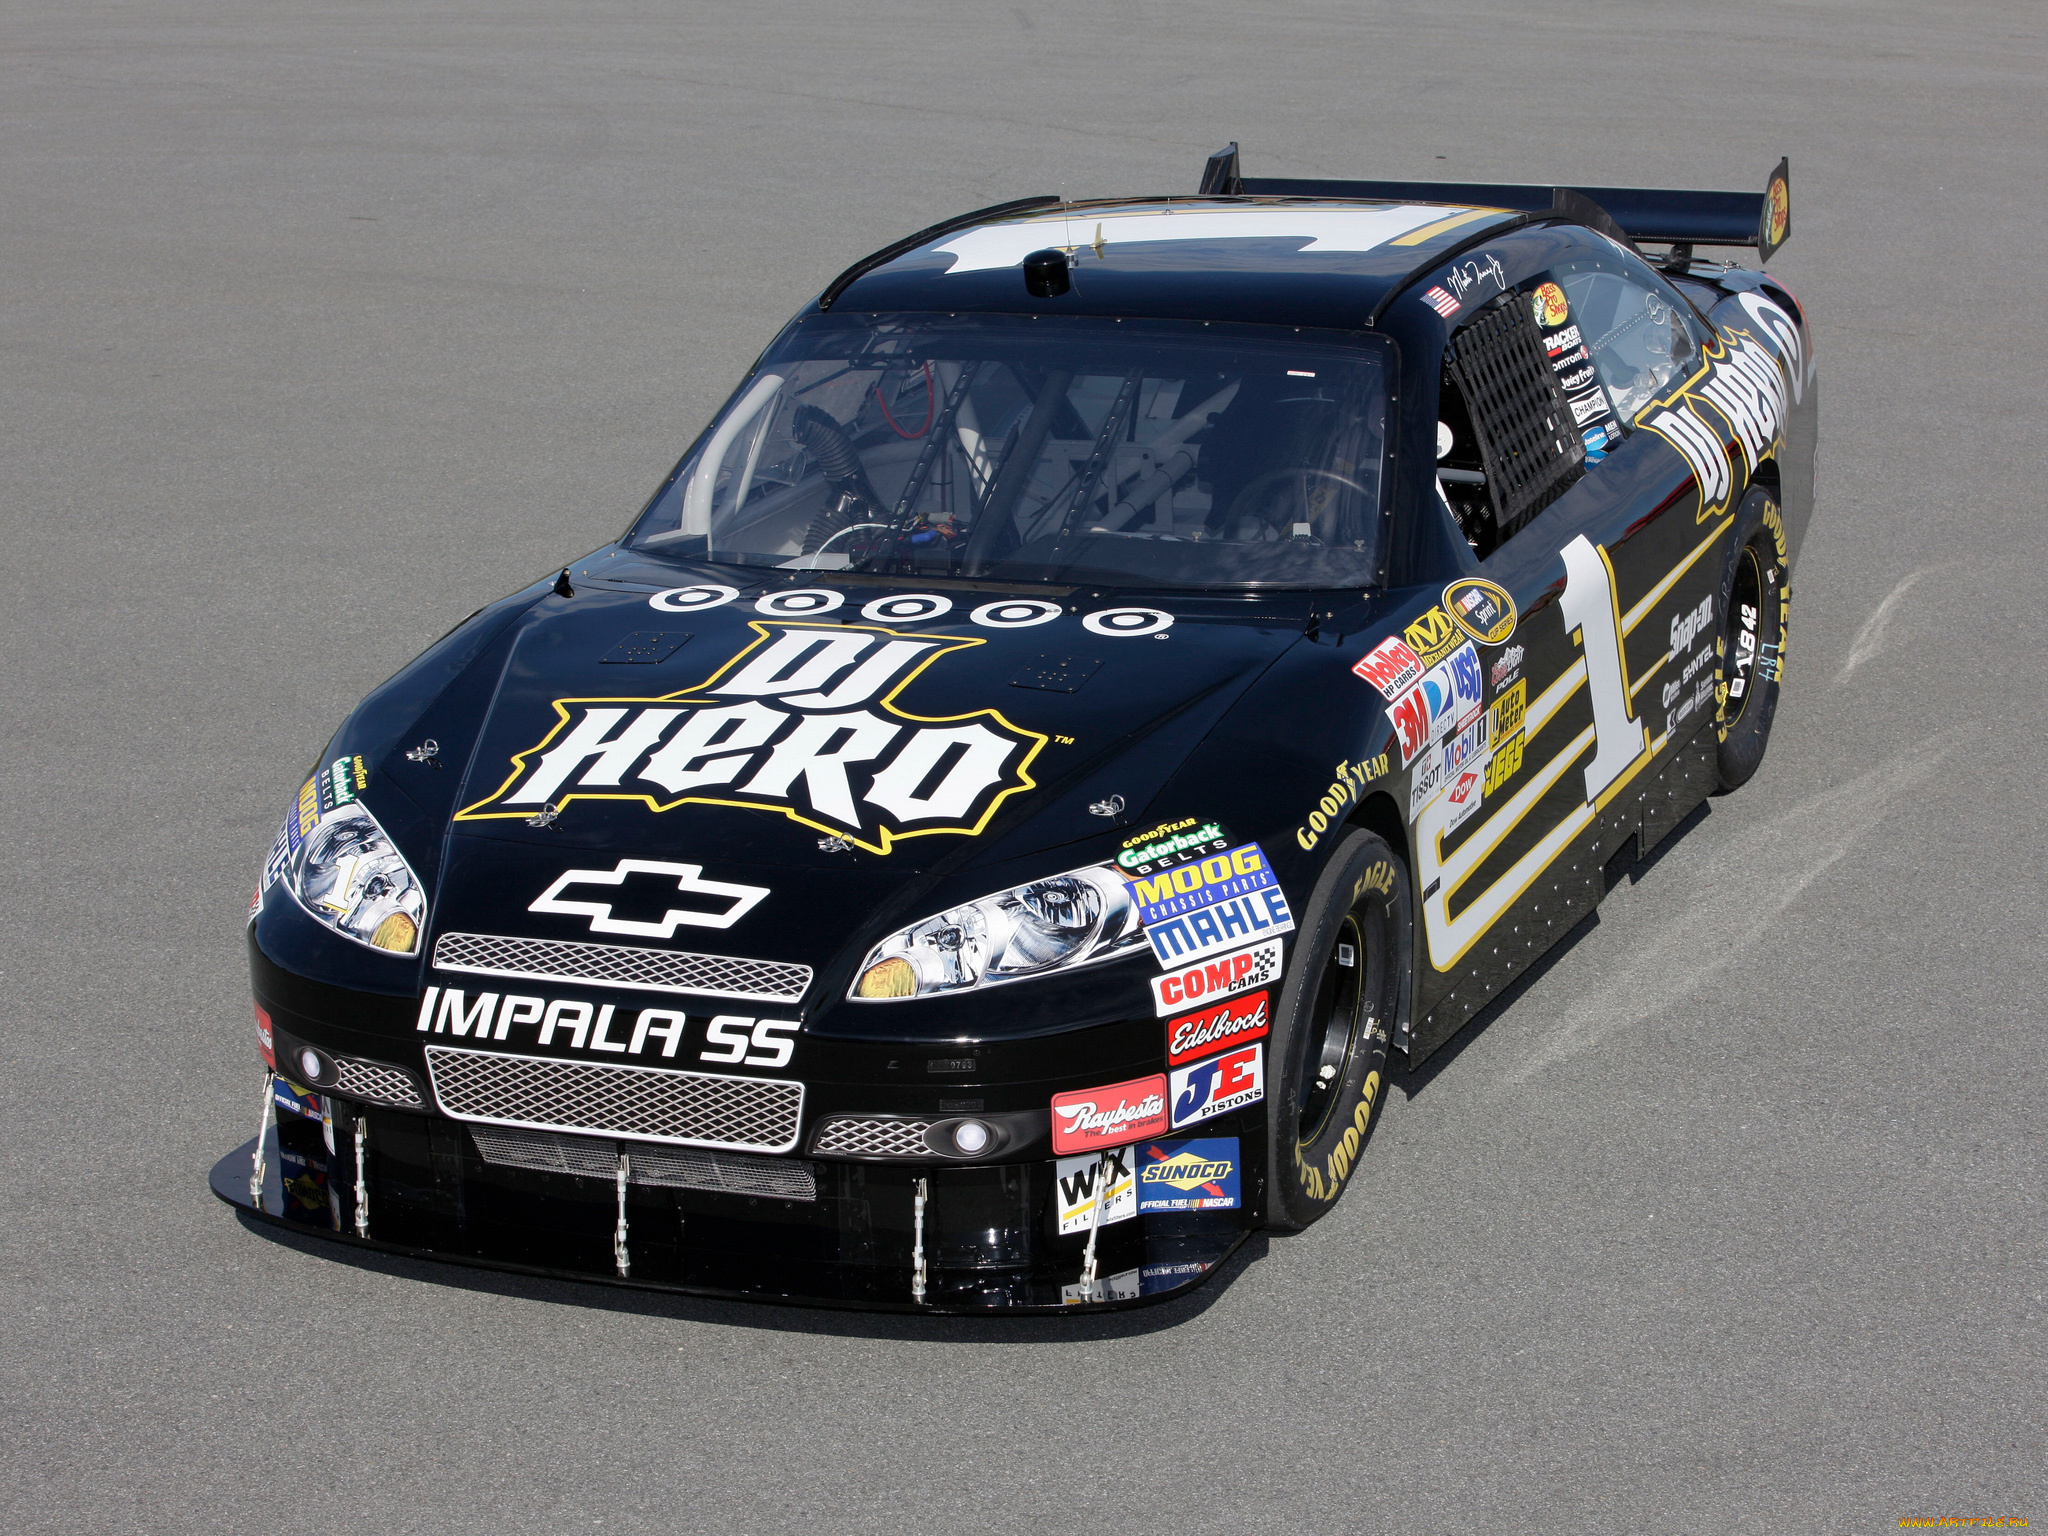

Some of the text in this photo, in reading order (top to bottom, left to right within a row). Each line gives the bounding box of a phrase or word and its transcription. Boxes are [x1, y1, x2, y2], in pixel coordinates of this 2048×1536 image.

[1540, 284, 1556, 297] Bass
[1546, 294, 1558, 306] Pro
[1550, 301, 1567, 317] Shops
[1562, 337, 1582, 351] BOATS
[1561, 374, 1580, 389] Juicy
[1574, 397, 1605, 417] CHAMPION
[1604, 420, 1618, 432] MEN
[1475, 600, 1496, 625] Sprint
[1490, 615, 1514, 640] CUP SERIES
[1449, 628, 1466, 653] WEAR
[1356, 642, 1420, 689] Holley
[1383, 666, 1417, 698] HP CARBS
[1495, 668, 1520, 694] POLE
[1498, 704, 1524, 736] Meter
[1501, 689, 1520, 717] Auto
[1394, 687, 1429, 761] 3M
[1431, 711, 1455, 741] DIRECTV
[1445, 725, 1475, 775] Mobil
[1484, 731, 1525, 799] JEGS
[321, 769, 333, 809] BELTS
[332, 756, 357, 806] Gatorback
[353, 755, 367, 790] GOODYEAR
[1412, 763, 1441, 808] TISSOT
[299, 775, 320, 838] MOOG
[1296, 752, 1390, 851] GOODYEAR
[1117, 823, 1225, 868] Gatorback
[1122, 817, 1197, 849] GOODYEAR
[1136, 839, 1228, 875] BELTS
[1133, 845, 1263, 908] MOOG
[1351, 861, 1395, 907] EAGLE
[1150, 872, 1268, 920] CHASSIS PARTS
[1148, 887, 1292, 961] MAHLE
[1159, 953, 1254, 1006] COMP
[1227, 969, 1270, 993] CAMS
[416, 986, 802, 1067] IMPALA SS
[1170, 1000, 1268, 1056] Edelbrock
[1173, 1047, 1257, 1124] JE
[1201, 1088, 1263, 1117] PISTONS
[1054, 1094, 1164, 1135] Raybestos
[1084, 1116, 1164, 1138] The best in brakes
[1146, 1162, 1228, 1181] SUNOCO
[1063, 1189, 1132, 1231] FILERS
[1140, 1197, 1234, 1209] OFFICIAL FUEL NASCAR
